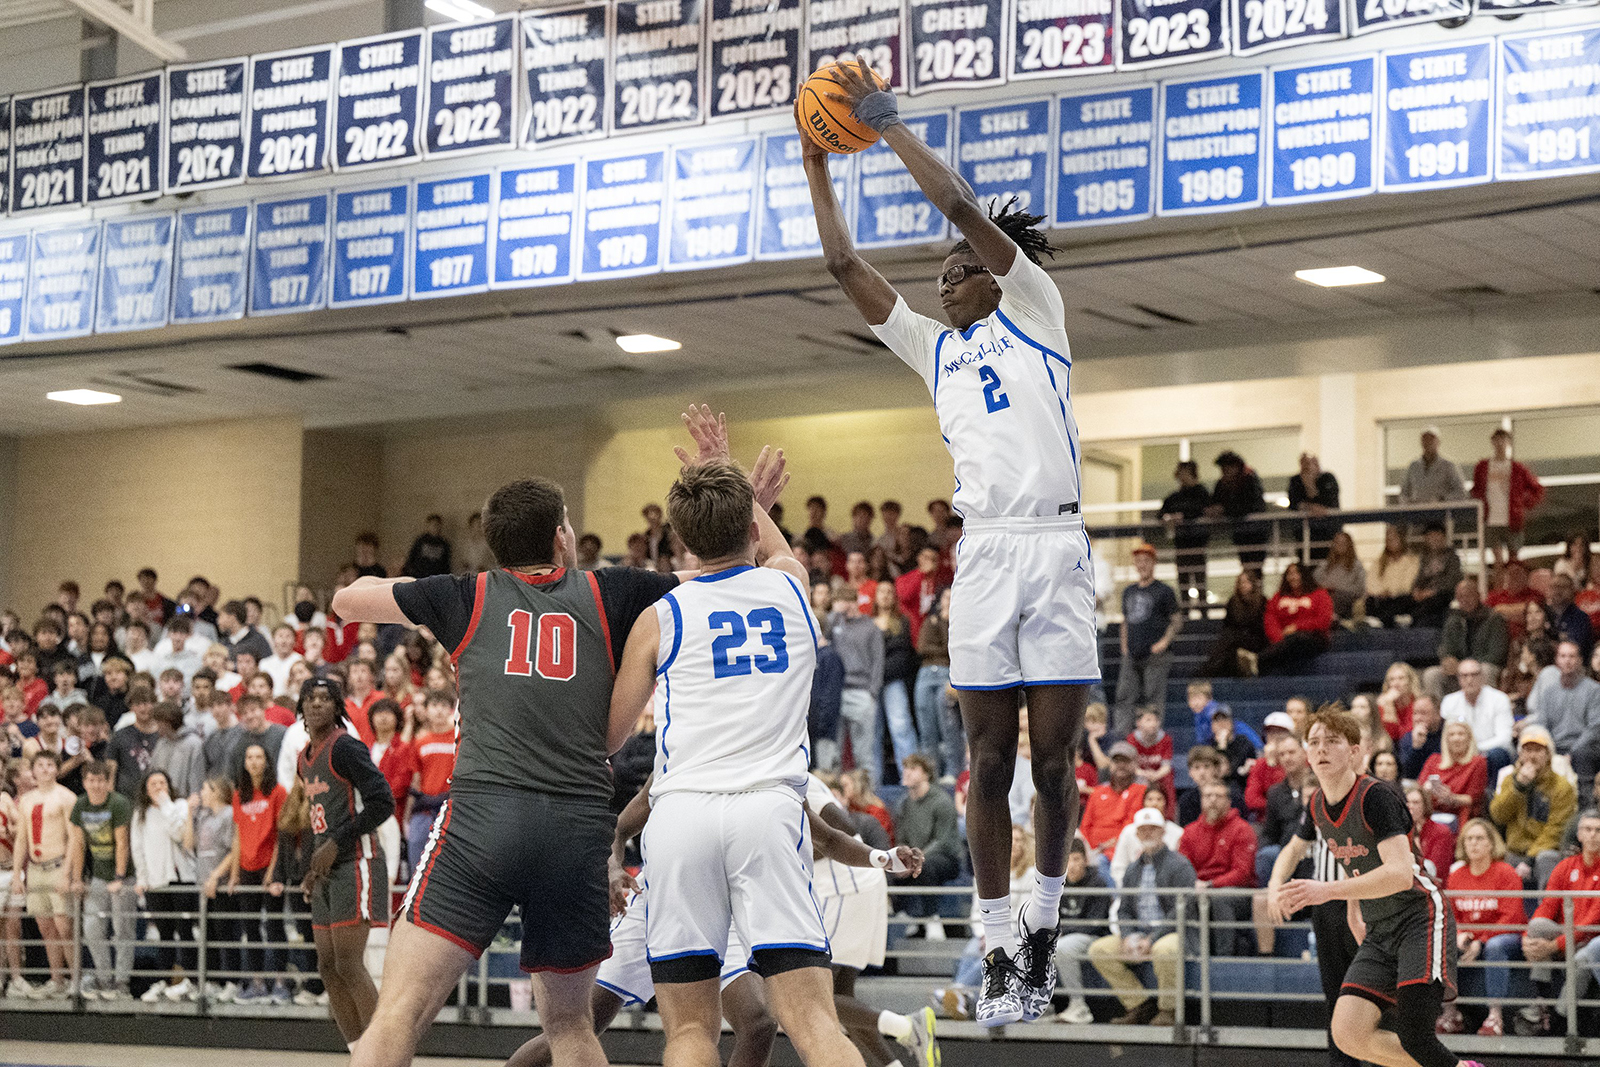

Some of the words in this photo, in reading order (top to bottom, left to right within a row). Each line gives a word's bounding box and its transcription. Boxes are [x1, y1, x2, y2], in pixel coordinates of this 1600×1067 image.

[541, 14, 588, 40] STATE
[636, 2, 682, 27] STATE
[712, 8, 802, 42] CHAMPION
[922, 4, 988, 34] CREW
[1245, 0, 1328, 43] 2024
[450, 26, 497, 53] STATE
[617, 24, 699, 56] CHAMPION
[1022, 22, 1105, 70] 2023
[1128, 8, 1210, 58] 2023
[1528, 35, 1585, 62] STATE
[359, 42, 404, 69] STATE
[432, 48, 512, 83] CHAMPION
[524, 38, 606, 70] CHAMPION
[722, 38, 788, 67] FOOTBALL
[916, 36, 994, 82] 2023
[1409, 53, 1467, 80] STATE
[187, 69, 226, 94] STATE
[271, 56, 314, 83] STATE
[339, 64, 419, 98] CHAMPION
[538, 67, 588, 92] TENNIS
[1296, 68, 1352, 95] STATE
[105, 81, 145, 108] STATE
[253, 79, 330, 111] CHAMPION
[620, 79, 692, 125] 2022
[718, 64, 791, 112] 2023
[1186, 83, 1240, 109] STATE
[1388, 78, 1489, 111] CHAMPION
[31, 95, 70, 119] STATE
[89, 102, 158, 135] CHAMPION
[171, 92, 242, 120] CHAMPION
[261, 108, 317, 133] FOOTBALL
[534, 94, 597, 140] 2022
[1080, 97, 1132, 123] STATE
[1275, 92, 1373, 125] CHAMPION
[1406, 106, 1468, 134] TENNIS
[15, 116, 82, 146] CHAMPION
[435, 101, 502, 146] 2022
[810, 110, 858, 152] Wilson
[980, 109, 1030, 135] STATE
[1062, 122, 1152, 152] CHAMPION
[1166, 108, 1260, 138] CHAMPION
[1276, 118, 1370, 150] WRESTLING
[258, 132, 317, 175] 2021
[345, 119, 408, 163] 2022
[961, 133, 1049, 162] CHAMPION
[1167, 132, 1257, 161] WRESTLING
[1525, 126, 1590, 164] 1991
[602, 158, 647, 184] STATE
[1062, 146, 1148, 175] WRESTLING
[1290, 151, 1356, 191] 1990
[1405, 140, 1469, 178] 1991
[20, 168, 74, 208] 2021
[98, 156, 150, 198] 2021
[516, 170, 560, 194] STATE
[1178, 166, 1244, 203] 1986
[353, 192, 392, 215] STATE
[433, 181, 474, 205] STATE
[1074, 179, 1135, 216] 1985
[272, 203, 310, 225] STATE
[337, 214, 406, 240] CHAMPION
[418, 202, 489, 231] CHAMPION
[875, 202, 930, 236] 1982
[779, 215, 823, 247] 198
[348, 265, 390, 296] 1977
[429, 254, 474, 287] 1977
[270, 274, 309, 304] 1977
[978, 364, 1011, 414] 2
[504, 608, 576, 682] 10
[707, 606, 789, 680] 23
